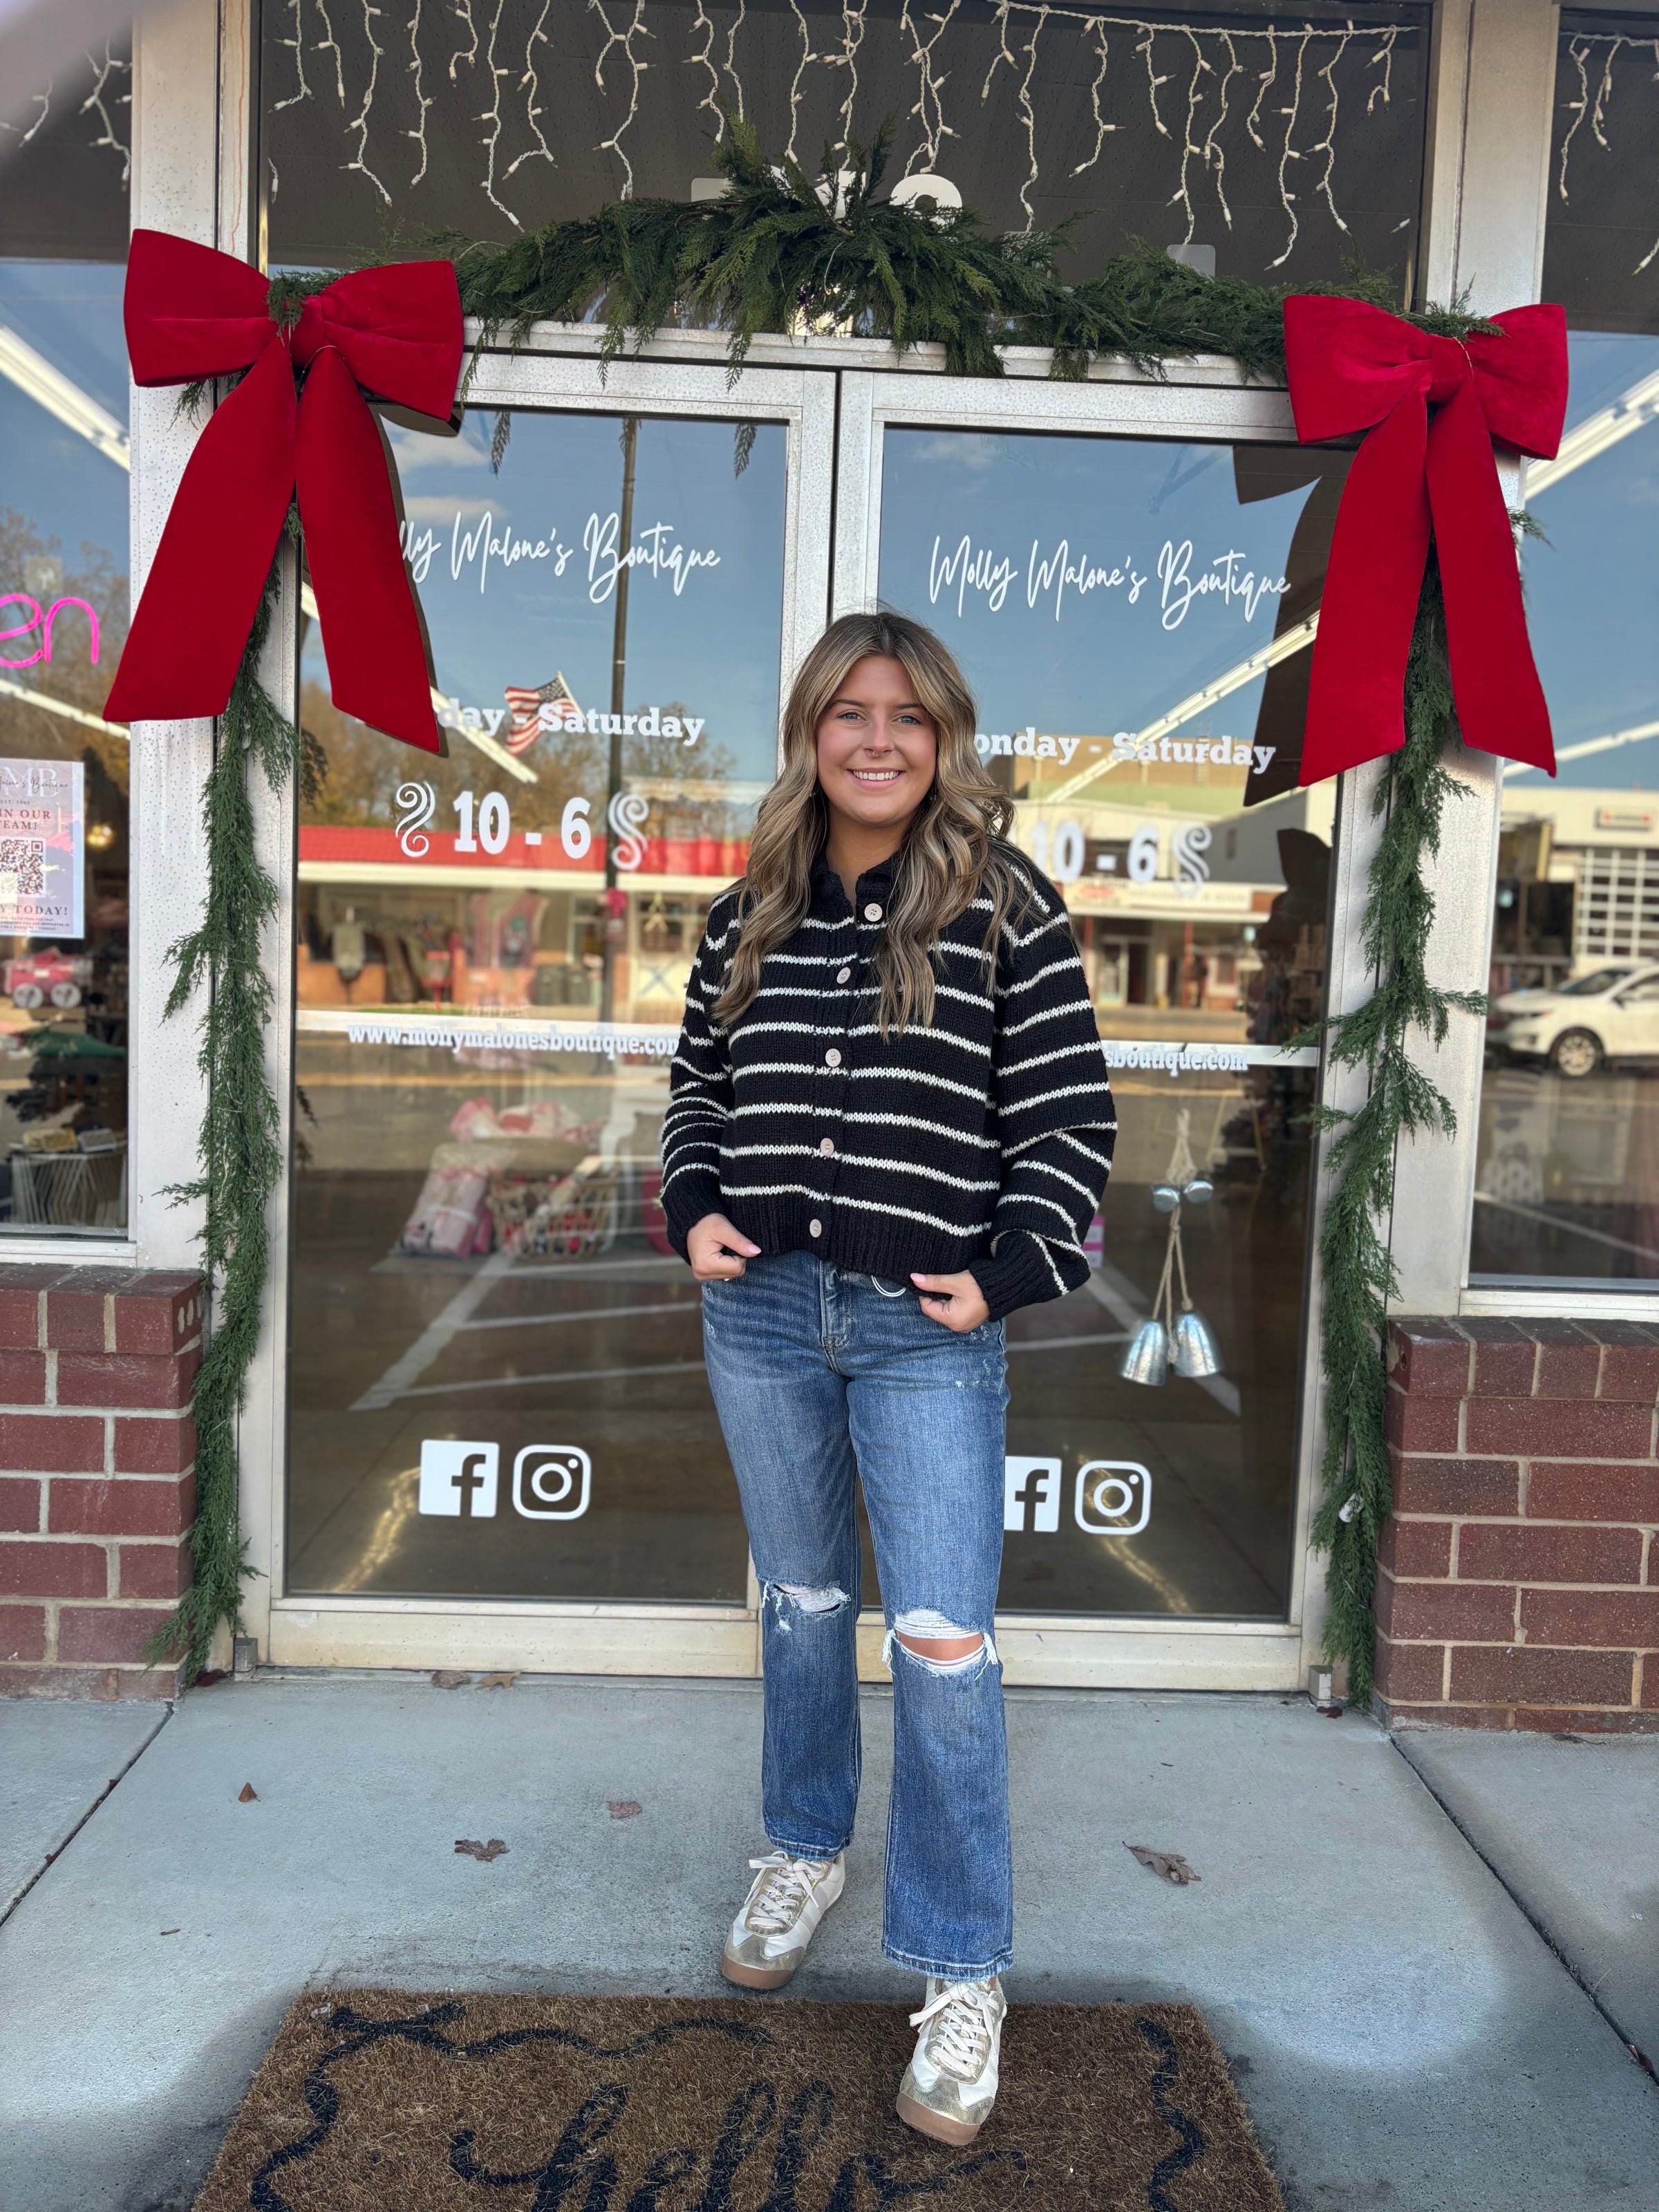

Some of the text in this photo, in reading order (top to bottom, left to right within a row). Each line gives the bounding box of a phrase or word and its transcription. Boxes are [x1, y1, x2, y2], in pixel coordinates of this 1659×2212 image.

[451, 511, 574, 594] Malone's
[583, 512, 720, 603] Boutique
[930, 535, 1291, 630] Molly Malone's Boutique
[537, 702, 705, 746] Saturday
[1112, 731, 1276, 774] Saturday
[19, 809, 50, 819] OUR
[453, 791, 510, 854] 10
[561, 797, 591, 859] 6
[1030, 820, 1085, 885] 10
[1127, 825, 1159, 885] 6
[15, 904, 68, 916] TODAY!
